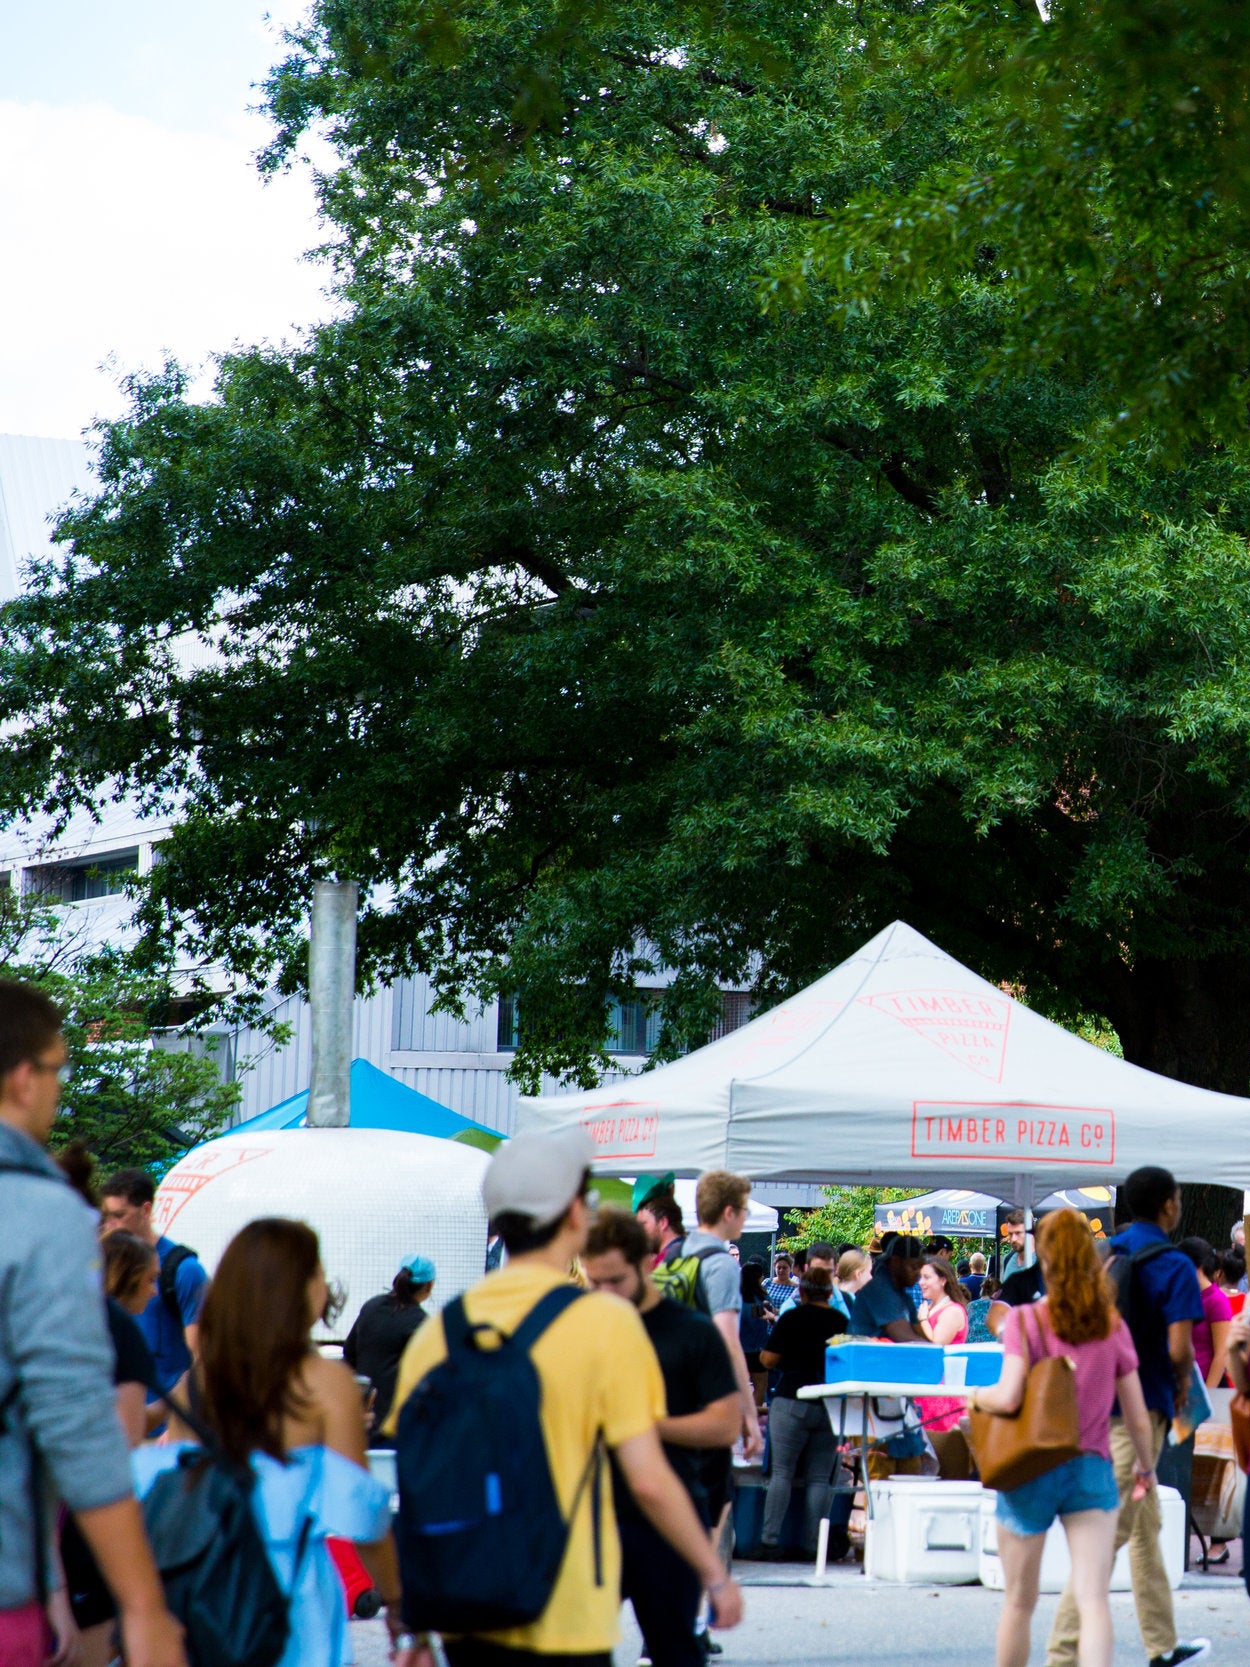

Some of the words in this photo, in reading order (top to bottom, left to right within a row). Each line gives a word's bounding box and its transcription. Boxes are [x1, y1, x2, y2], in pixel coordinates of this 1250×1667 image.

[891, 996, 998, 1017] TIMBER
[936, 1032, 997, 1049] PIZZA
[924, 1117, 1006, 1144] TIMBER
[1017, 1120, 1070, 1147] PIZZA
